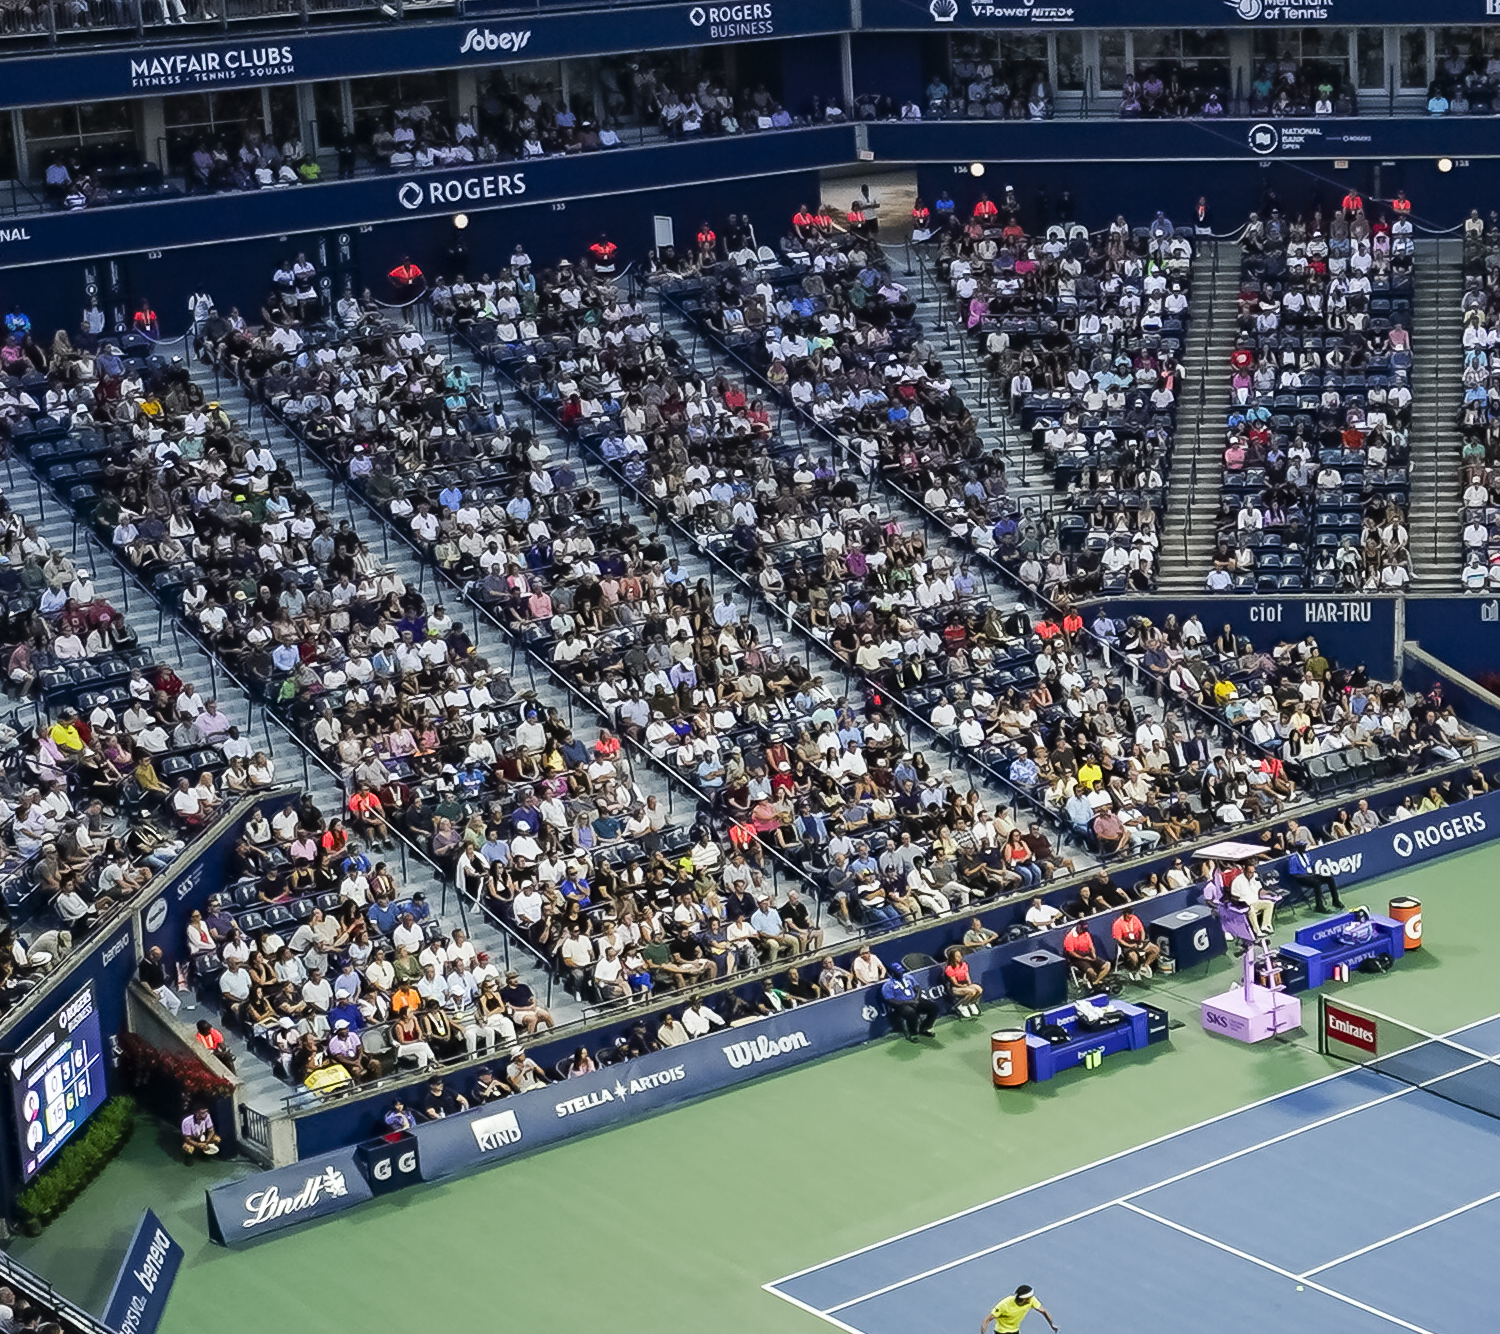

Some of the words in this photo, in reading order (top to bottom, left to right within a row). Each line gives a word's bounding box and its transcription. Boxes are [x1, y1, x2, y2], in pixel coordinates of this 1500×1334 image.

[709, 3, 773, 23] ROGERS
[1264, 6, 1281, 20] of
[1283, 6, 1328, 20] Tennis
[460, 27, 532, 54] Sobeys
[709, 20, 774, 38] BUSINESS
[130, 54, 220, 78] MAYFAIR
[223, 47, 294, 68] CLUBS
[132, 75, 180, 88] FITNESS
[194, 71, 238, 83] TENNIS
[250, 65, 296, 78] SQUASH
[430, 173, 527, 204] ROGERS
[1250, 602, 1284, 623] ciot
[1304, 602, 1373, 623] HAR-TRU
[1413, 811, 1487, 850] ROGERS
[1193, 927, 1211, 952] G
[1206, 1011, 1229, 1029] SKS
[1328, 1014, 1374, 1043] Emirates
[74, 1049, 83, 1068] 6
[722, 1030, 812, 1069] Wilson
[991, 1050, 1013, 1077] G
[555, 1088, 616, 1118] STELLA
[629, 1063, 687, 1097] ARTOIS
[479, 1126, 523, 1153] KIND
[373, 1157, 393, 1181] G
[397, 1149, 417, 1173] G
[242, 1174, 325, 1229] Lindt
[132, 1227, 171, 1295] beneva
